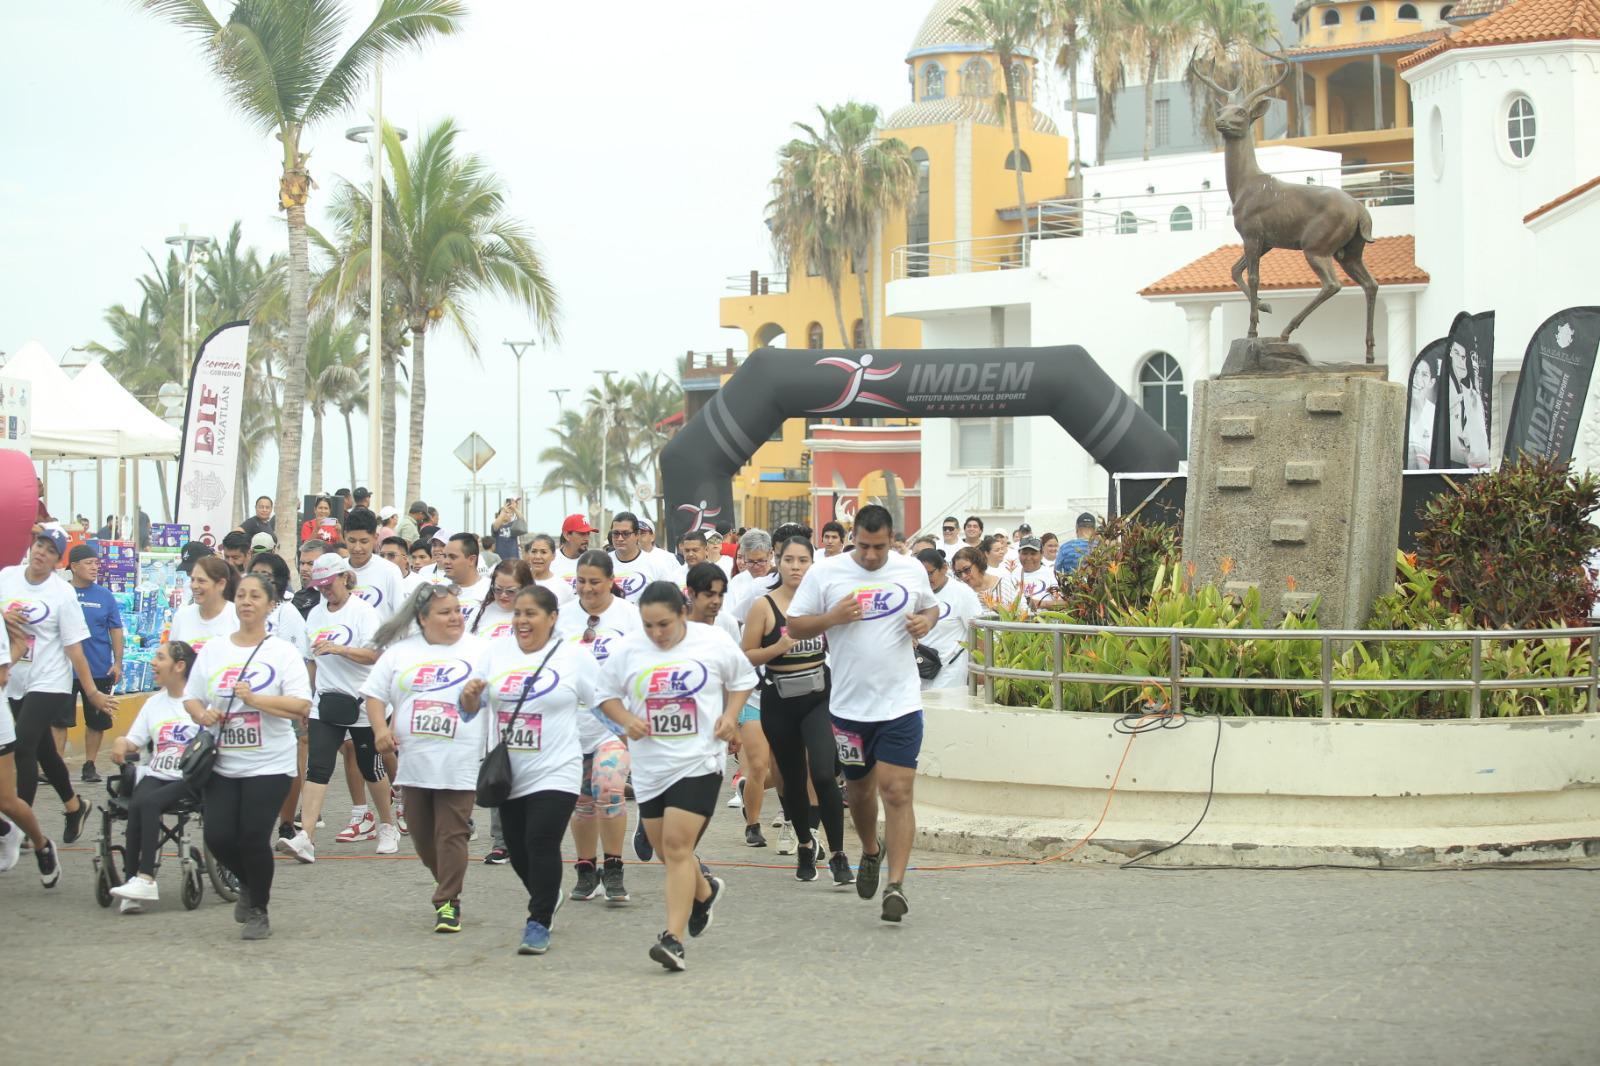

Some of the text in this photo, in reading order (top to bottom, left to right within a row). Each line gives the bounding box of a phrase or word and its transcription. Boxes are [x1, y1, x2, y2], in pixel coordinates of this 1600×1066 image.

[907, 361, 1035, 394] IMDEM
[1558, 374, 1570, 399] DEPORTE
[981, 393, 995, 401] DEL
[995, 392, 1027, 400] DEPORTE
[1523, 358, 1563, 457] MDEM
[194, 384, 218, 454] DIF
[216, 385, 231, 457] MAZATLÁN
[648, 670, 693, 692] 5K
[414, 715, 451, 735] 1284
[651, 713, 693, 733] 1294
[222, 727, 257, 746] 1086
